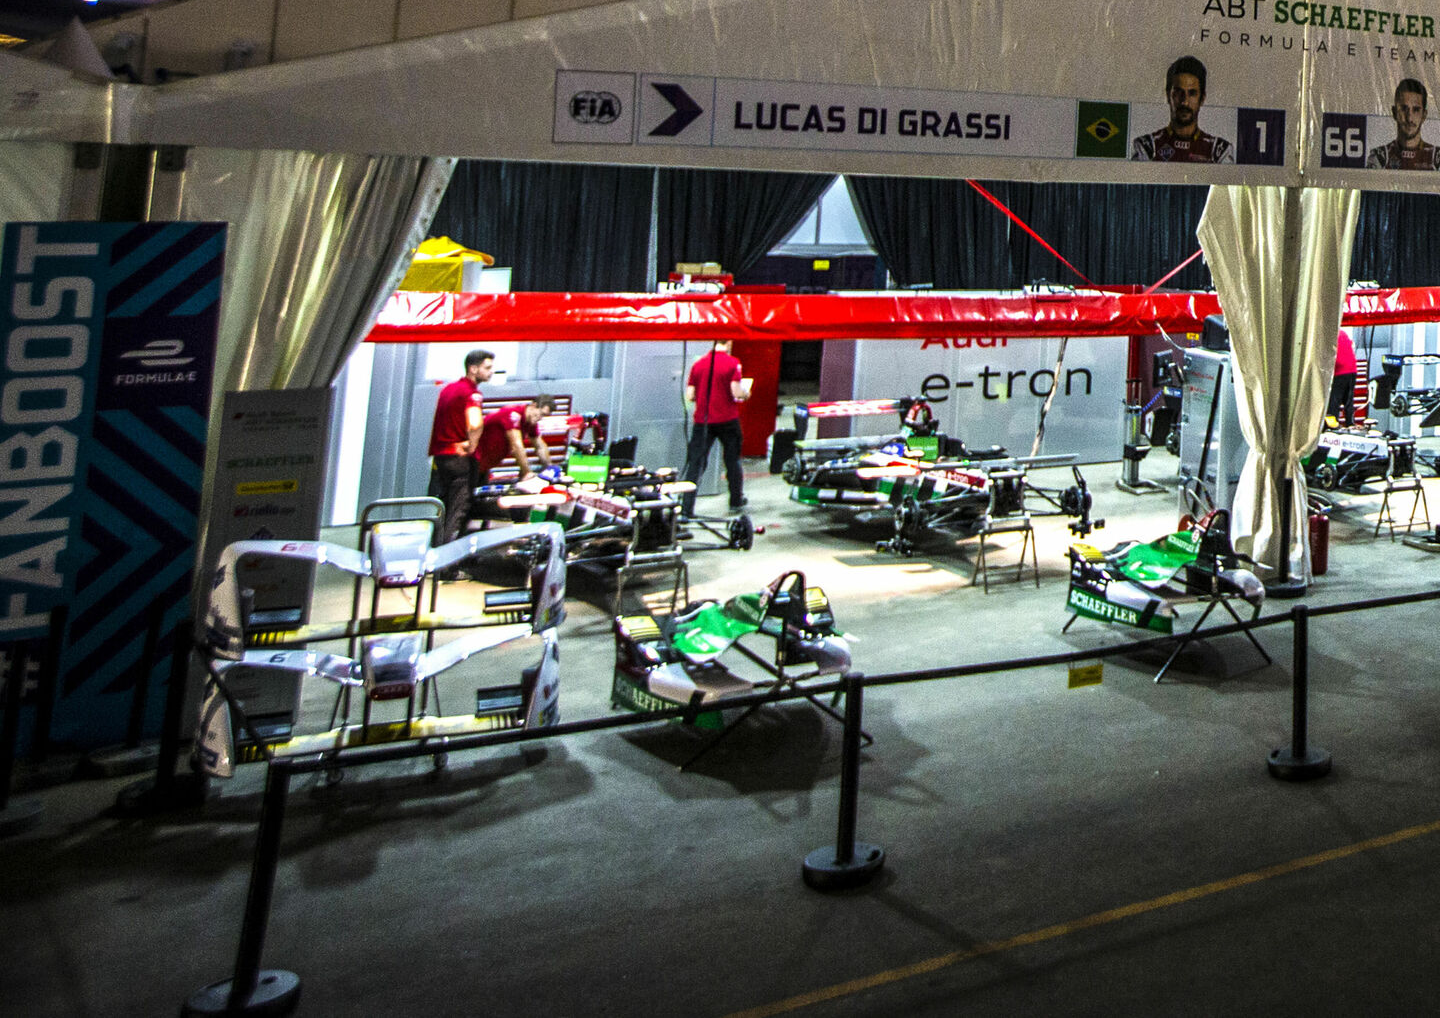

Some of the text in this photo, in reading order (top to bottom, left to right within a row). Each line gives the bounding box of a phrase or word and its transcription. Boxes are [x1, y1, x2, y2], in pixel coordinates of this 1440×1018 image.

[1200, 28, 1437, 63] FORMULA E TEAM
[734, 100, 1011, 141] LUCAS DI GRASSI
[1254, 121, 1269, 153] 1
[1325, 127, 1364, 159] 66
[921, 365, 1092, 403] e-tron
[1323, 437, 1341, 446] Audi
[1069, 588, 1138, 624] SCHAEFFLER
